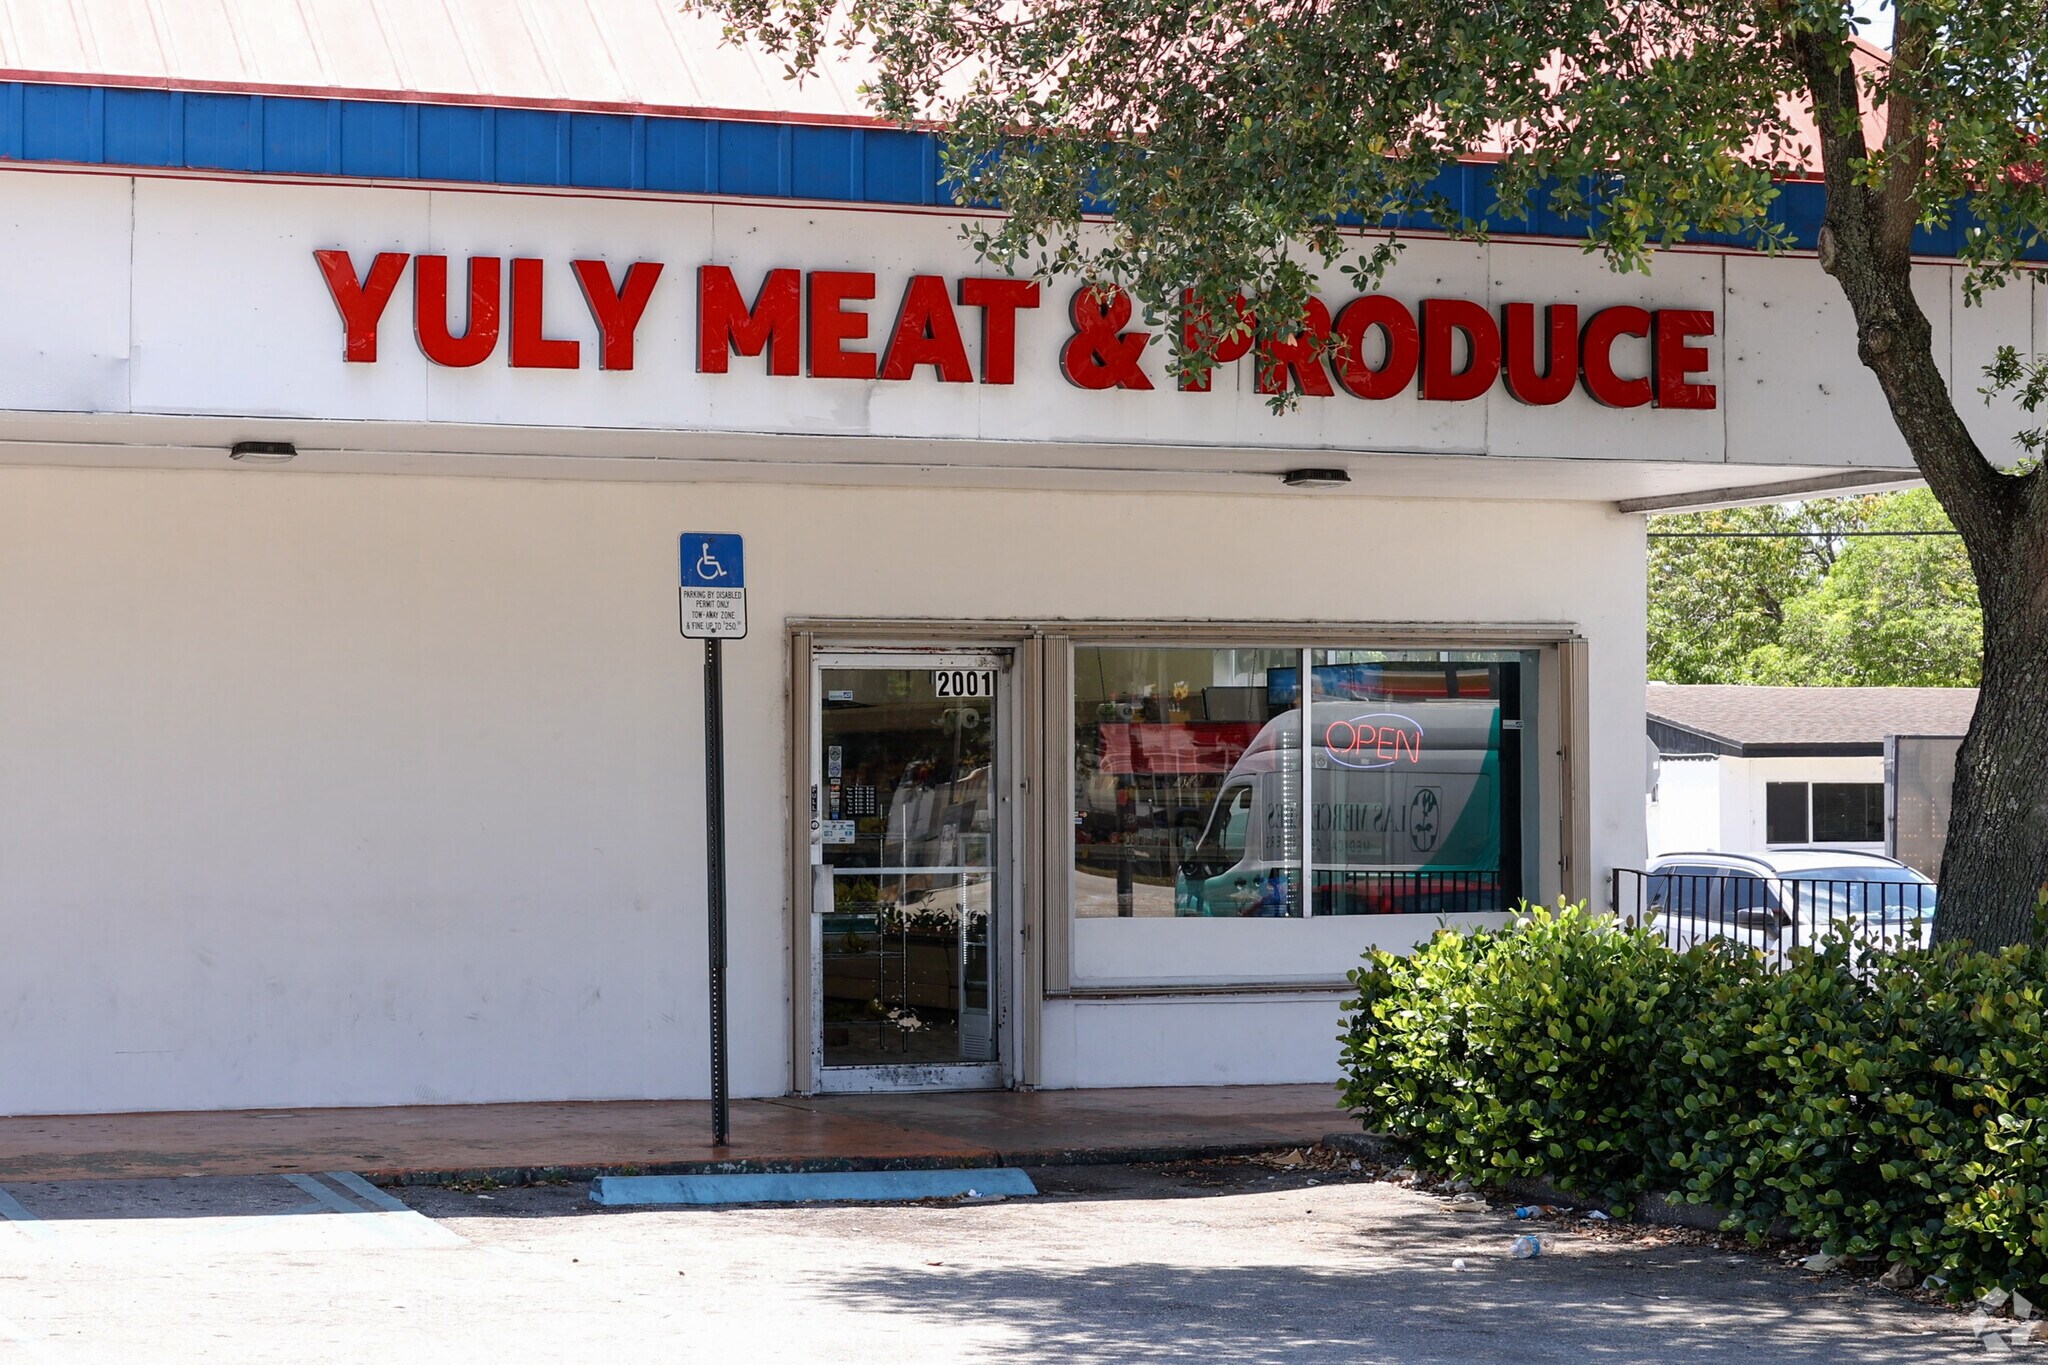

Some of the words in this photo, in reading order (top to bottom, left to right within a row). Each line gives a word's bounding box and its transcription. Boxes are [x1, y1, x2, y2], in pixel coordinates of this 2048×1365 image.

[314, 249, 664, 371] YULY
[697, 264, 1040, 384] MEAT
[1059, 282, 1155, 391] &
[1178, 286, 1717, 411] PRODUCE
[683, 590, 706, 599] PARKING
[707, 590, 715, 599] BY
[716, 591, 742, 599] DISABLED
[695, 599, 715, 608] PERMIT
[716, 600, 730, 608] ONLY
[691, 610, 719, 619] TOW-AWAY
[720, 611, 735, 619] ZONE
[686, 621, 690, 629] &
[691, 621, 704, 630] FINE
[705, 622, 714, 630] UP
[714, 622, 722, 630] TO
[938, 671, 991, 697] 2001
[1325, 720, 1421, 764] OPEN
